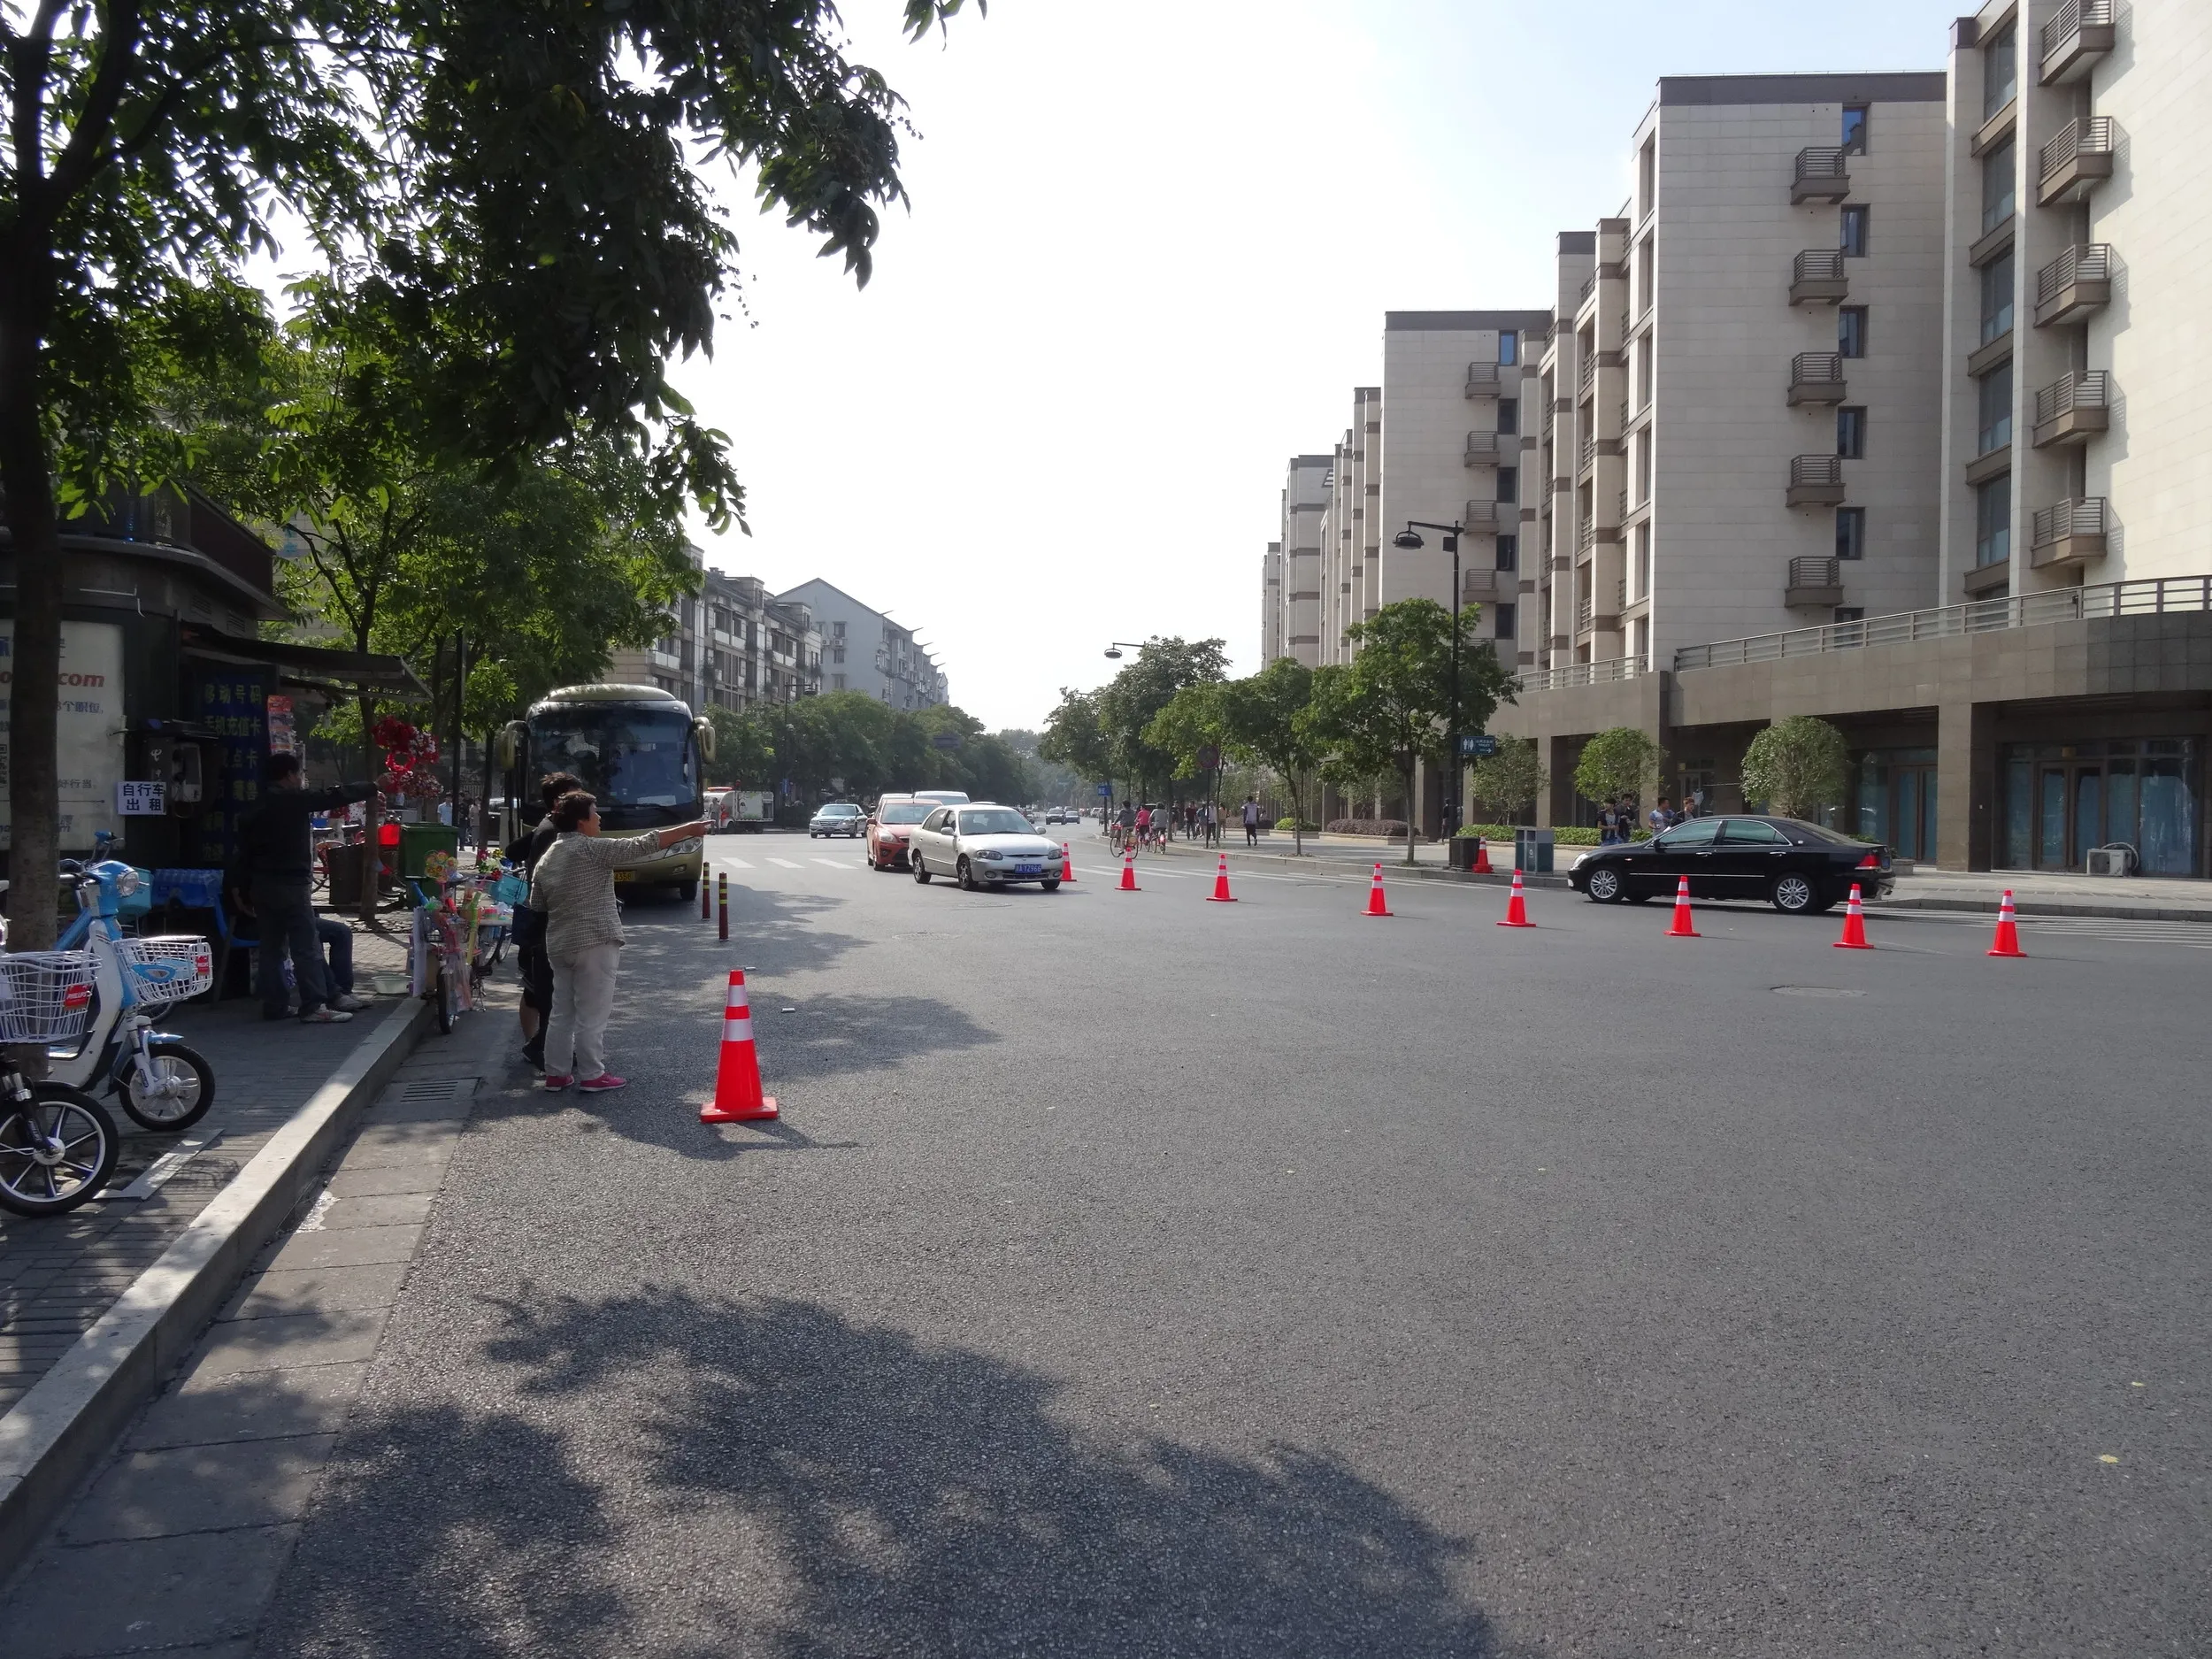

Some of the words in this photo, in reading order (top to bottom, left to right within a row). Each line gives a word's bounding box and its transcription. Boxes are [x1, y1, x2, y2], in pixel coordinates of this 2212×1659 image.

[204, 684, 262, 705] 移动号码
[204, 715, 262, 737] 手机充值卡
[123, 783, 165, 797] 自行车
